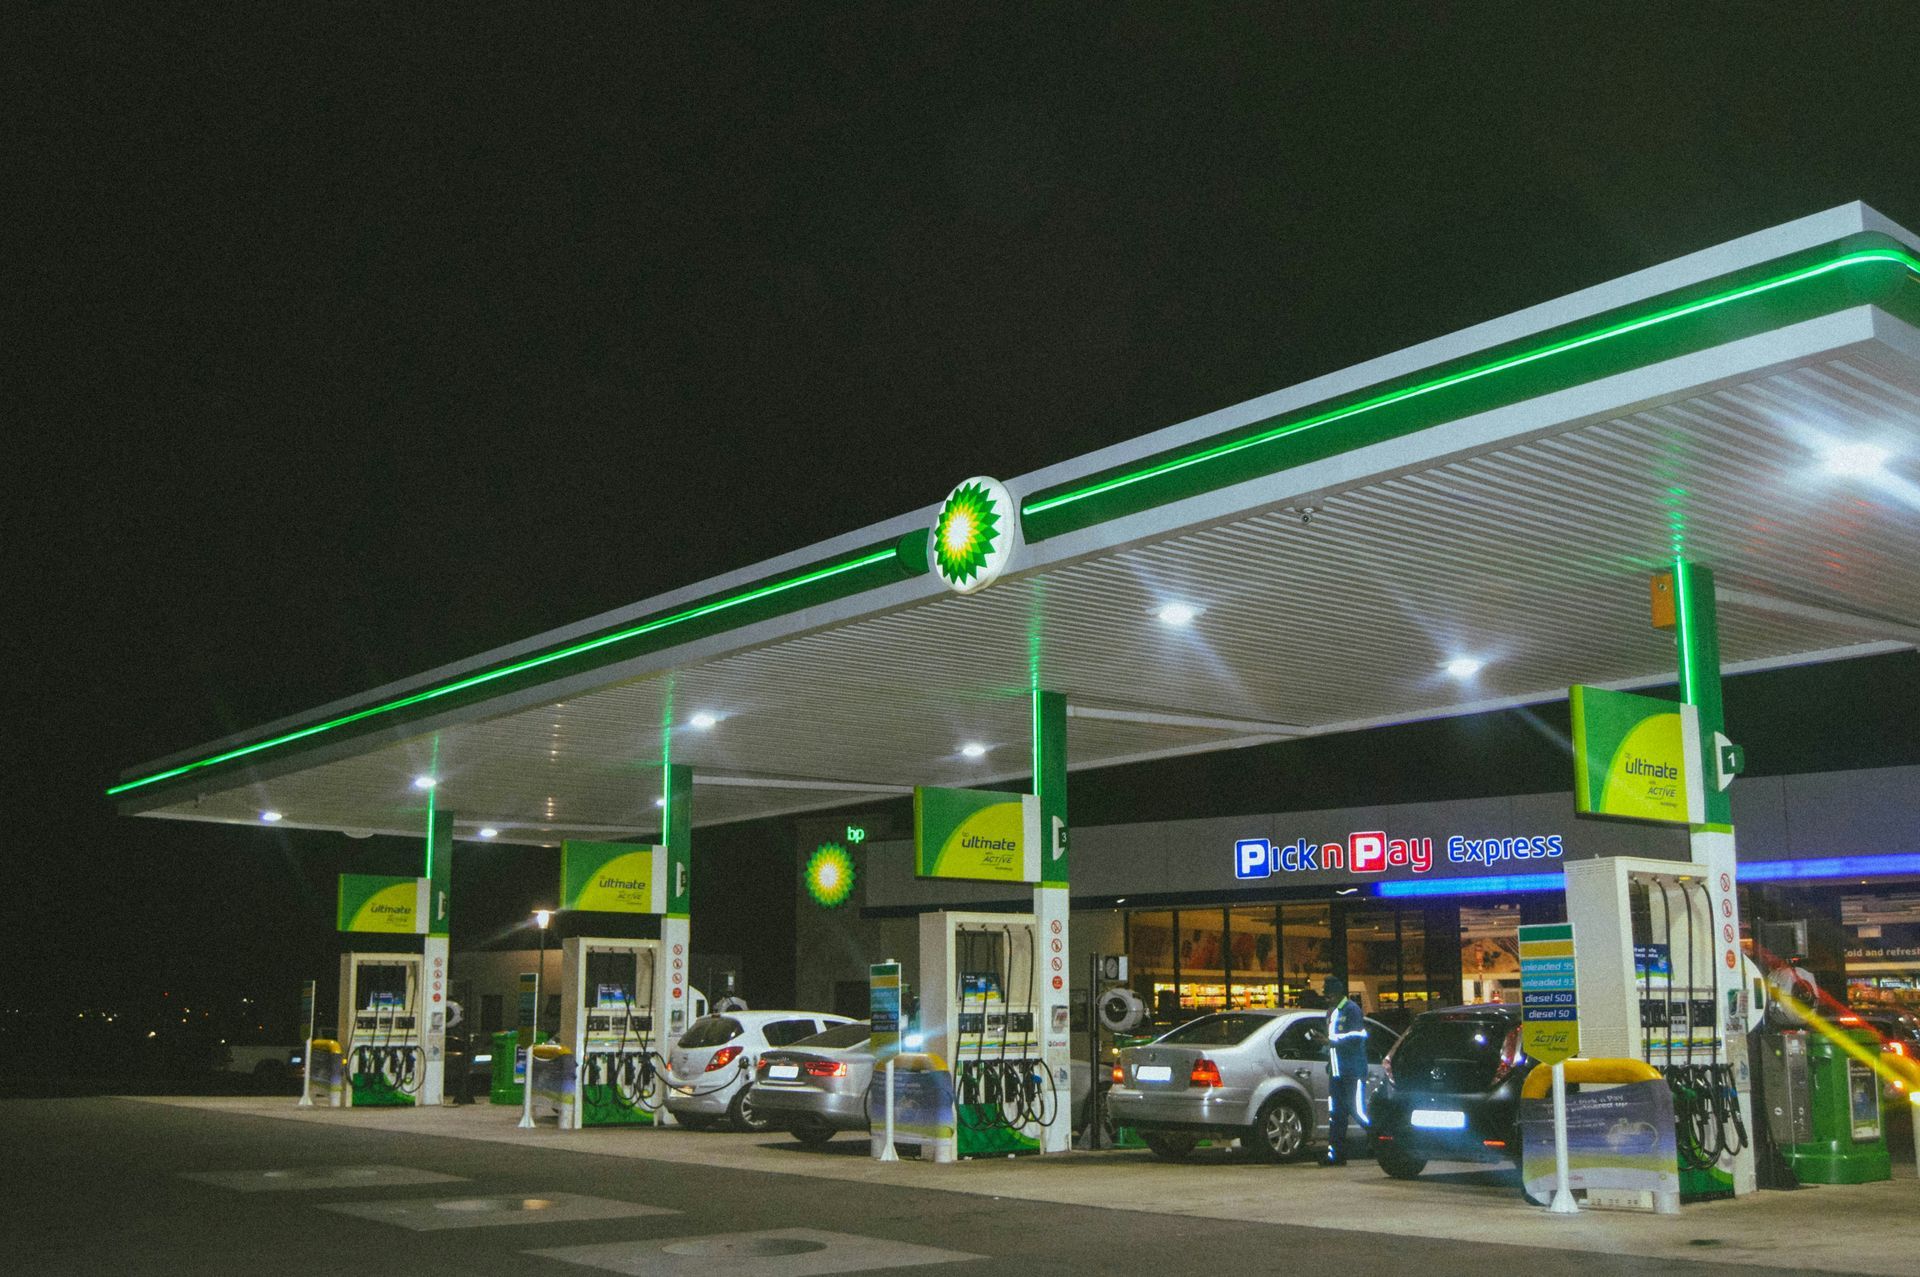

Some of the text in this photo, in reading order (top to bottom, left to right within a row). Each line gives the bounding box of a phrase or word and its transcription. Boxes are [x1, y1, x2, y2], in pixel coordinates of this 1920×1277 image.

[1728, 752, 1735, 767] 1
[1625, 758, 1678, 780] ultimate
[1647, 787, 1677, 797] ACTIVE
[847, 826, 865, 844] bp
[1062, 832, 1067, 842] 3
[961, 835, 1016, 851] ultimate
[1235, 831, 1563, 879] Pick n Pay Express
[599, 878, 646, 890] ultimate
[1865, 948, 1884, 957] and
[1525, 993, 1573, 1003] diesel 500
[1529, 1009, 1570, 1018] diesel 50
[1533, 1035, 1567, 1043] ACTIVE
